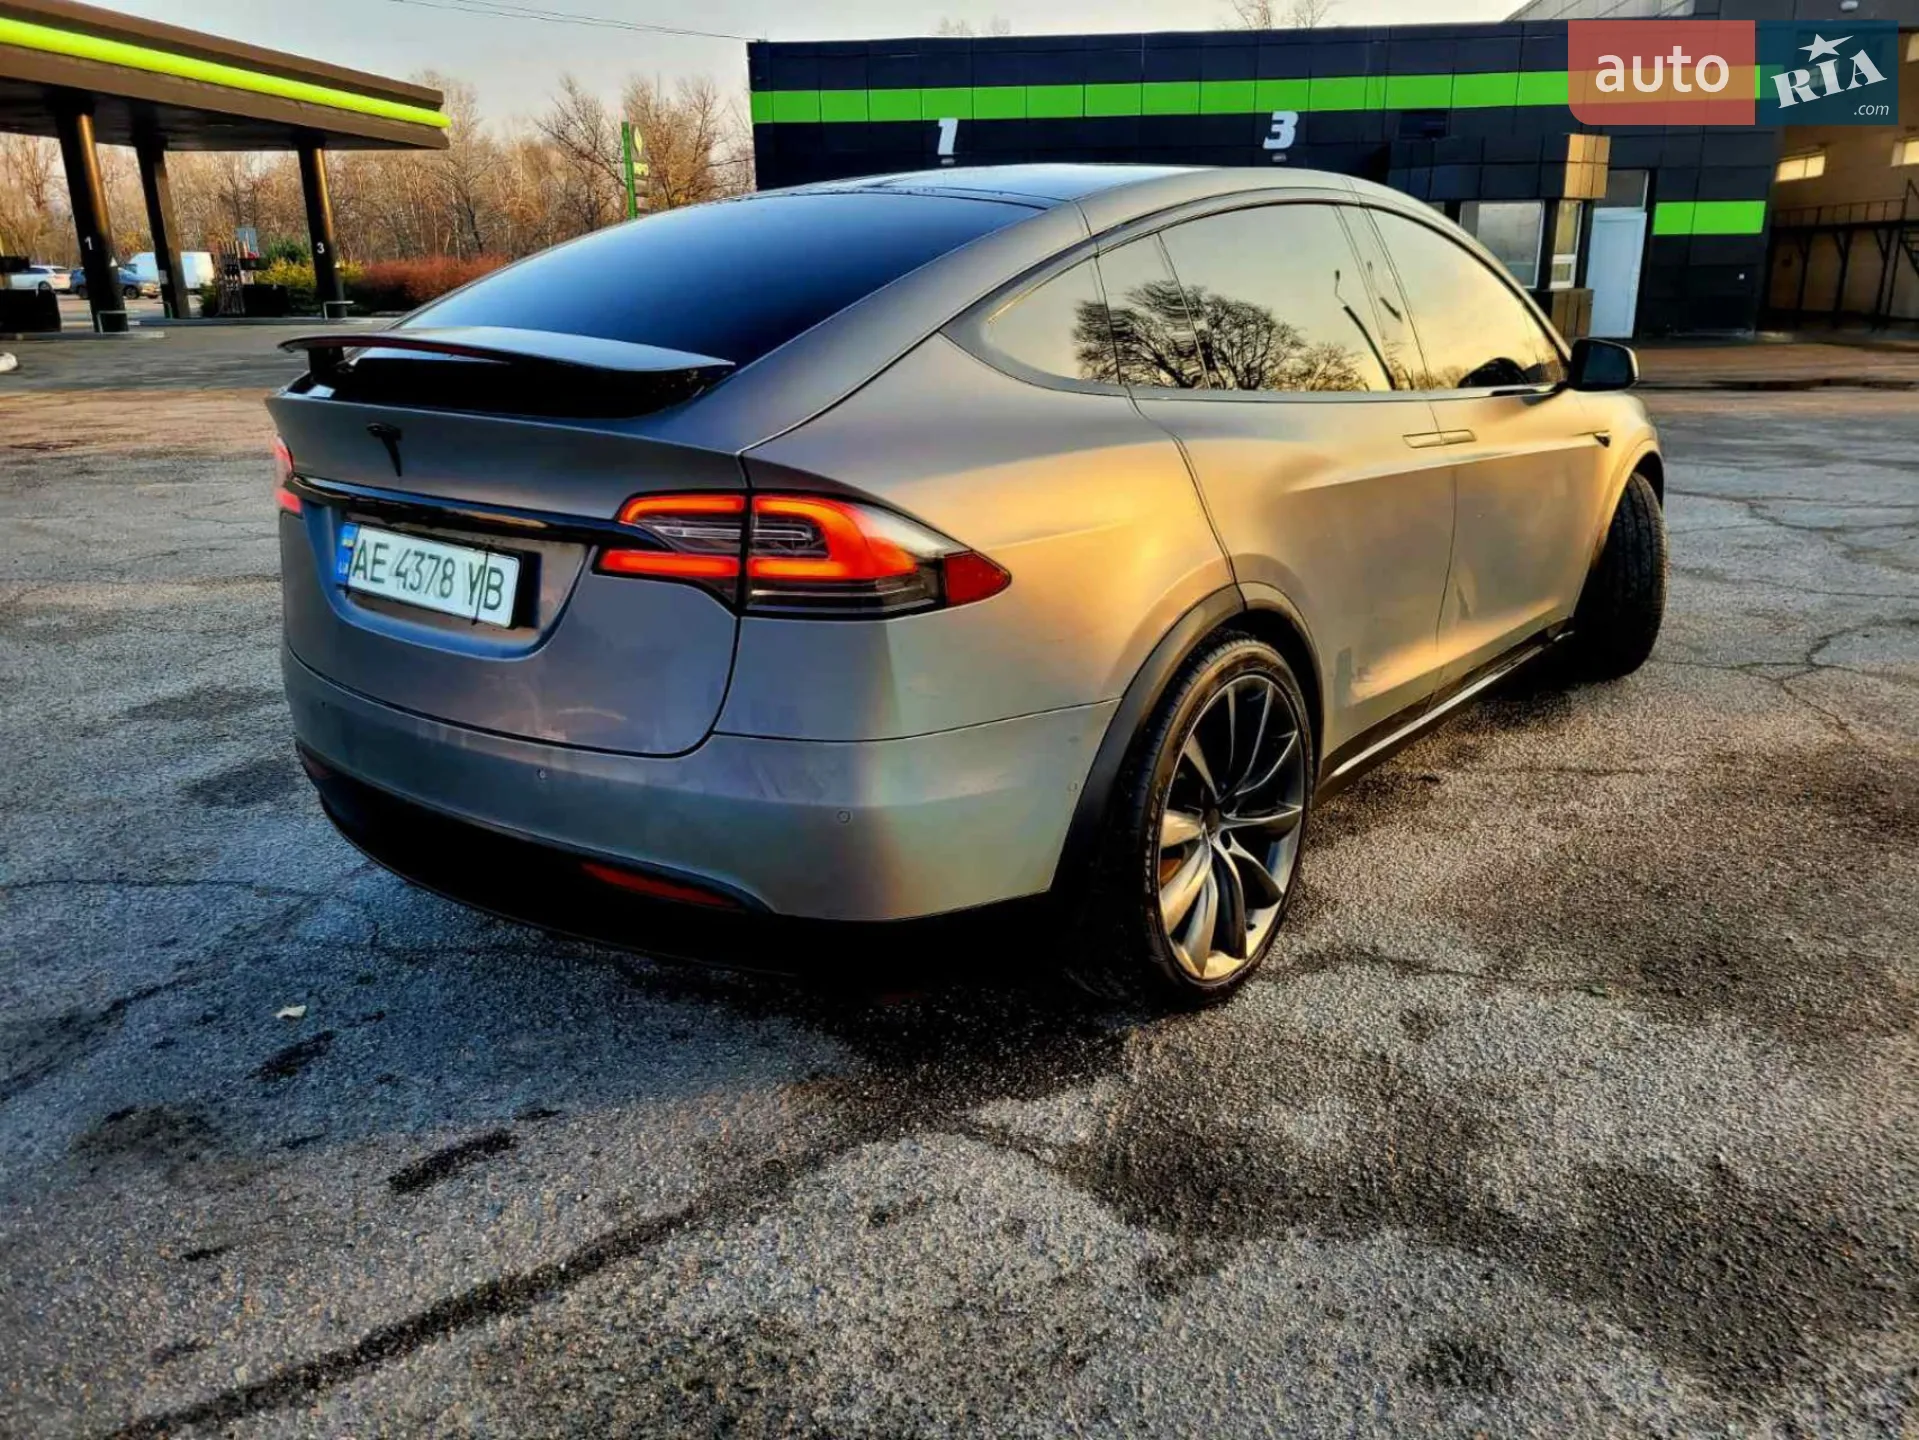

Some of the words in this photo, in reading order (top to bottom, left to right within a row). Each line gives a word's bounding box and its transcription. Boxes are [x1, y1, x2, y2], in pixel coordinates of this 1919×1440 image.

[937, 117, 958, 155] 1
[1262, 111, 1299, 150] 3
[84, 236, 94, 251] 1
[316, 241, 325, 254] 3
[352, 540, 389, 584] AE
[394, 548, 456, 599] 4378
